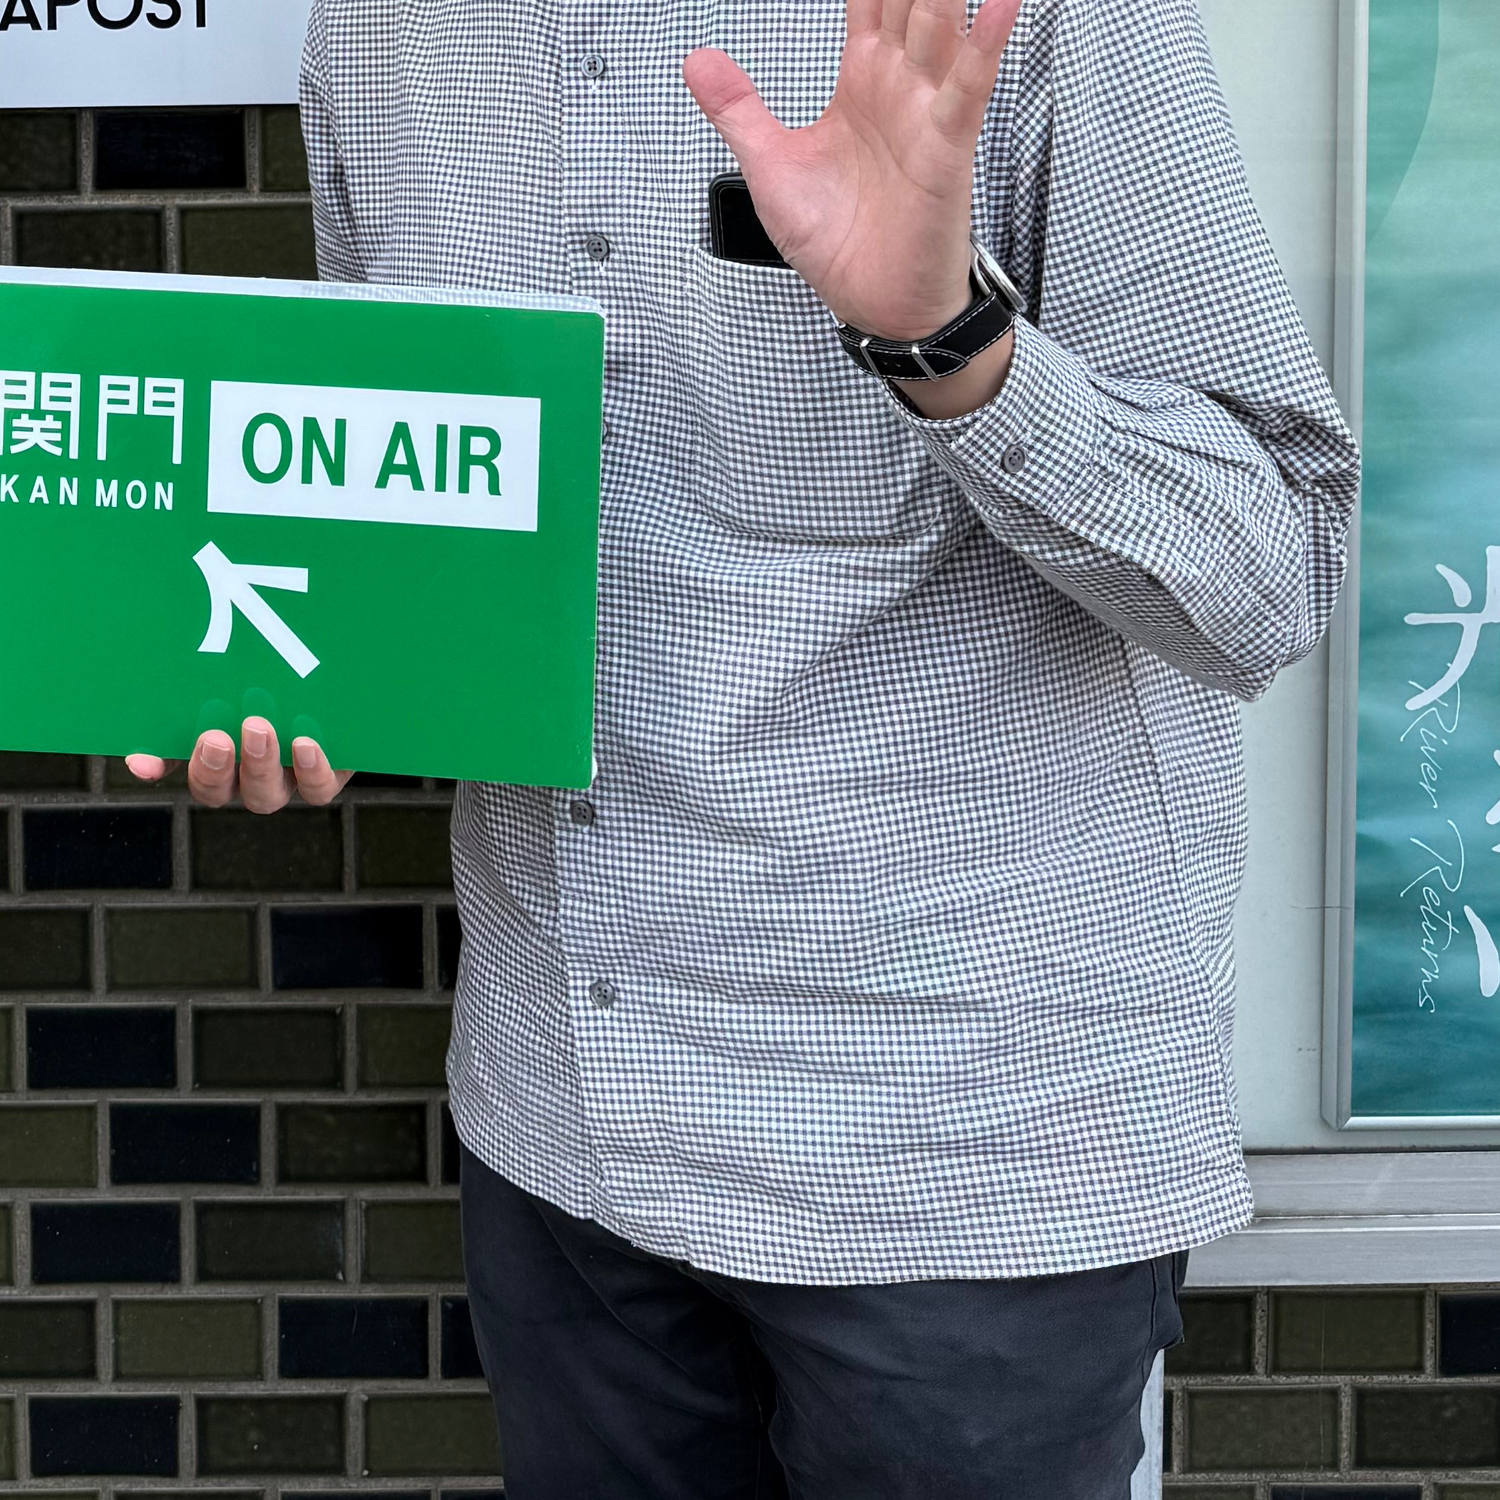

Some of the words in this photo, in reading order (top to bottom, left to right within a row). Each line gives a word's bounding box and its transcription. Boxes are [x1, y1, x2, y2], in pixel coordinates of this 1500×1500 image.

[241, 411, 348, 488] ON
[374, 420, 503, 498] AIR
[1399, 662, 1461, 809] River
[1399, 819, 1465, 1014] Returns
